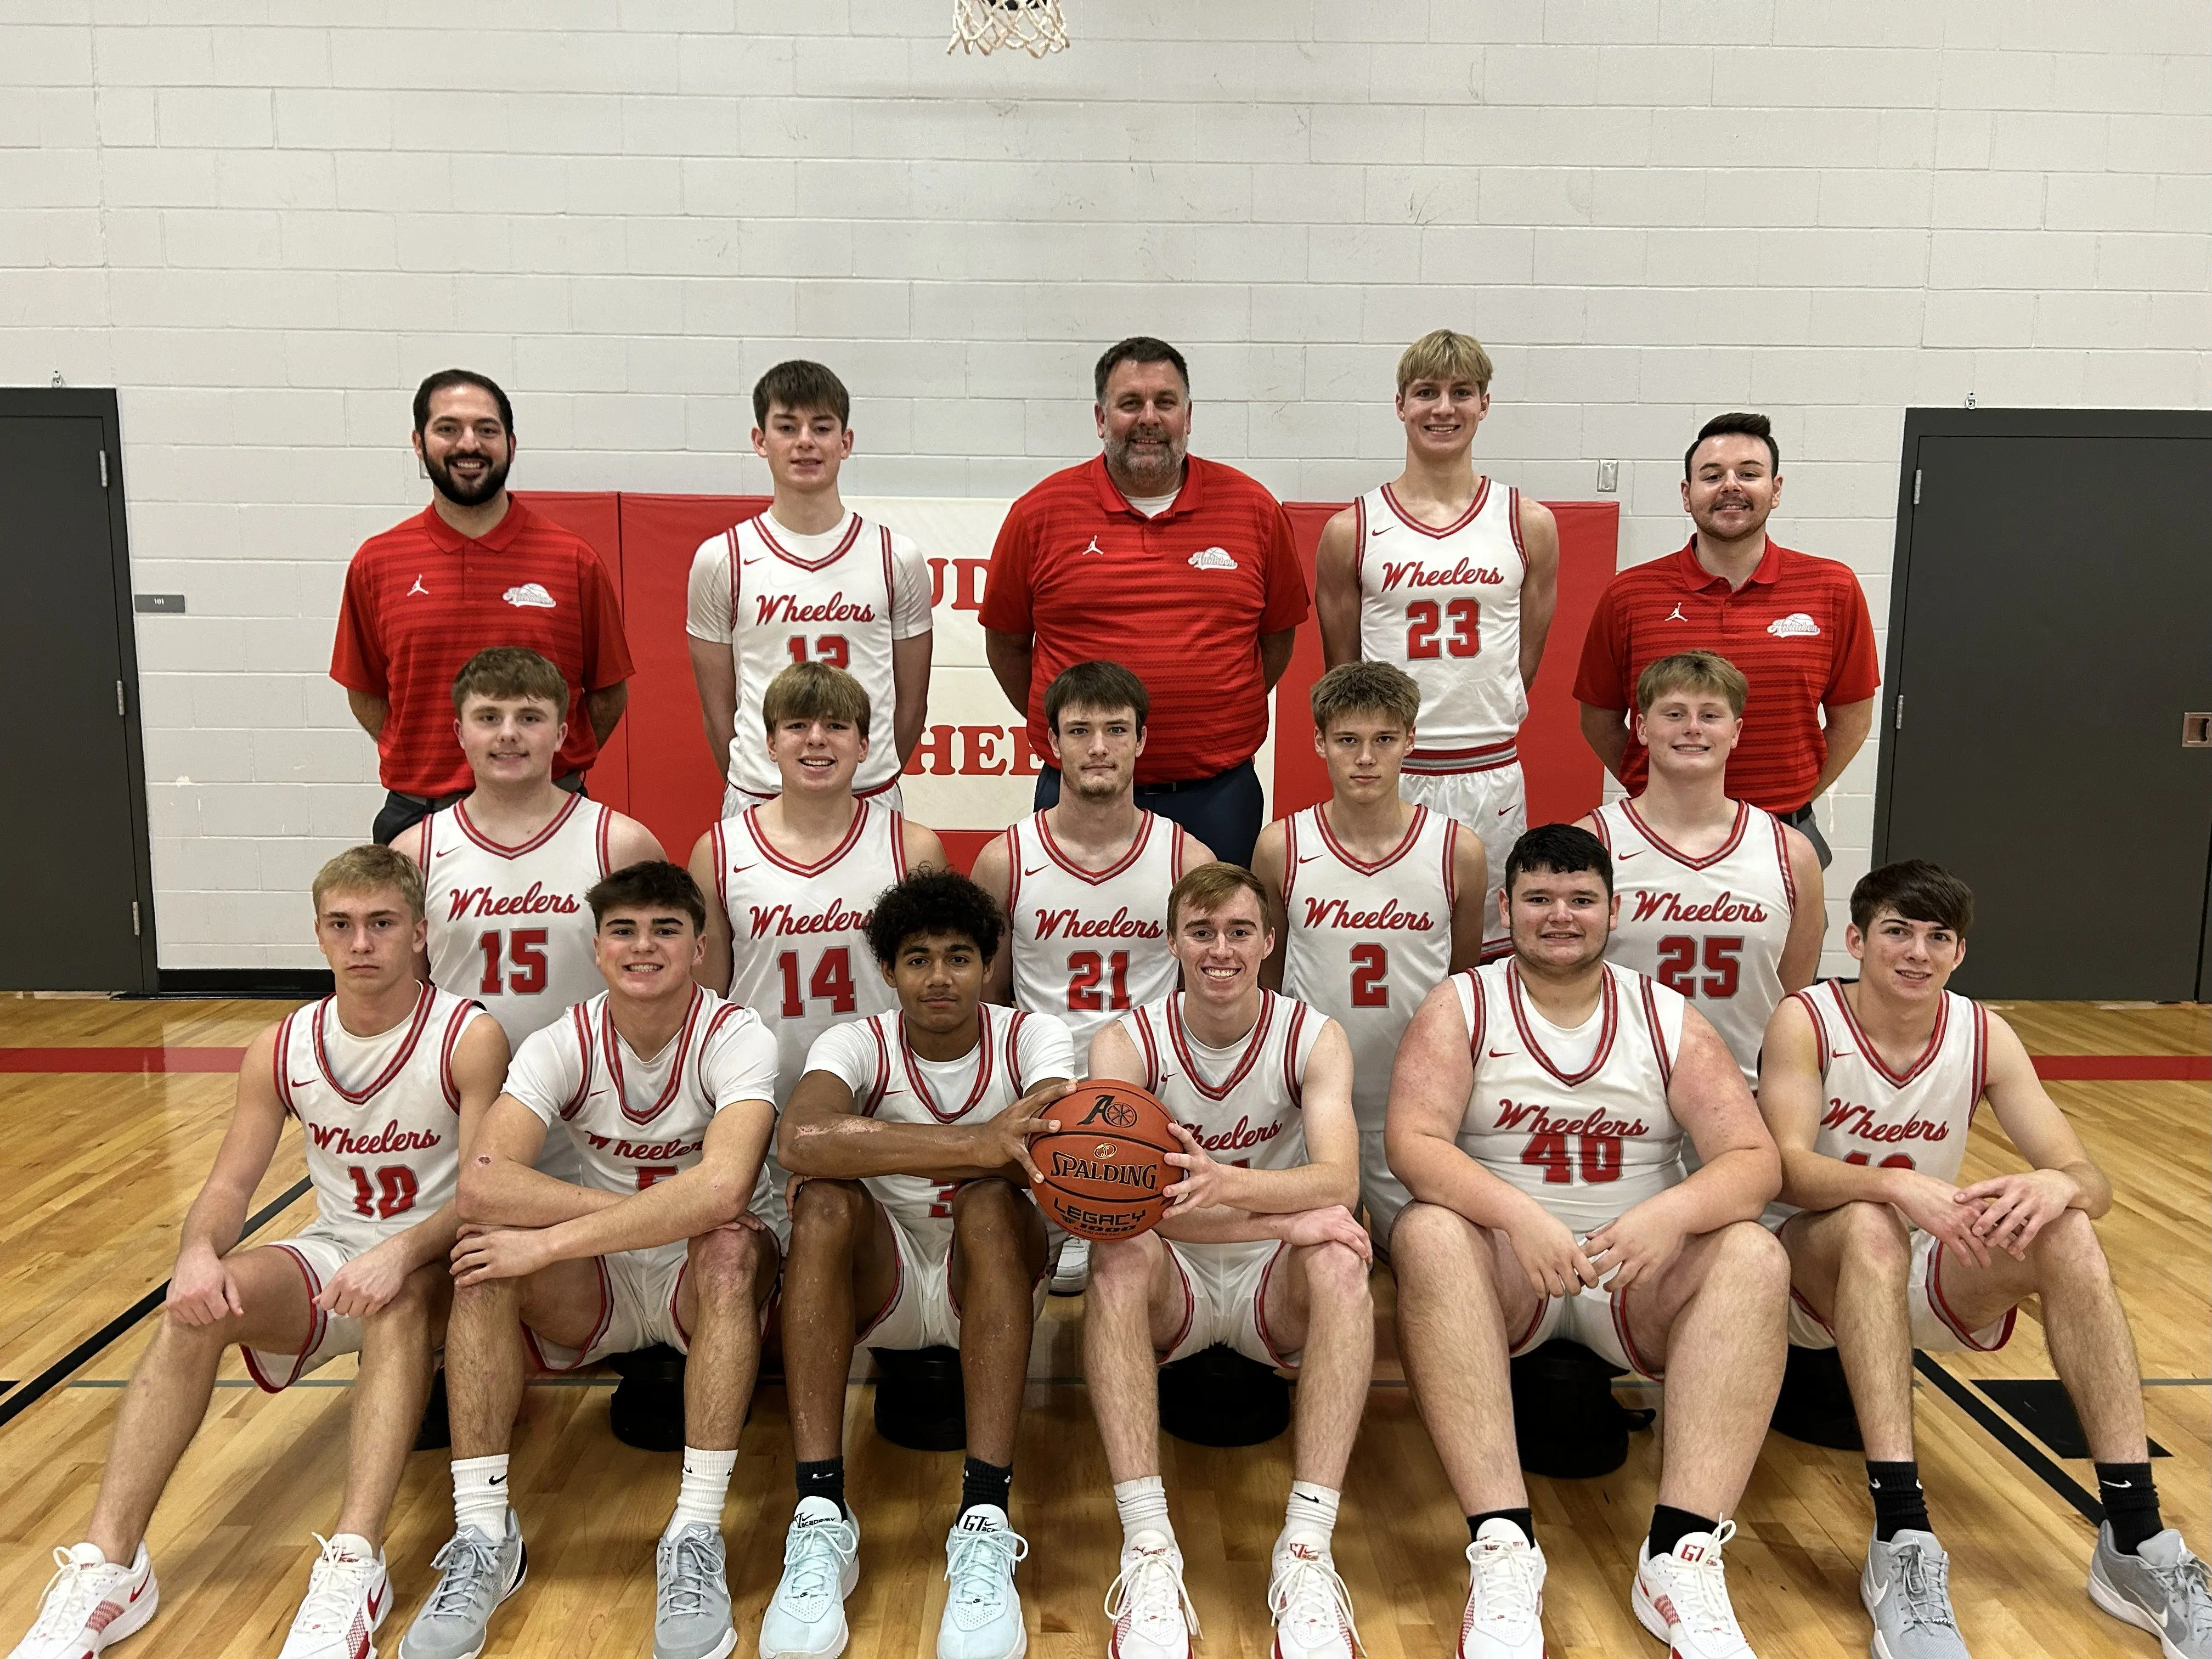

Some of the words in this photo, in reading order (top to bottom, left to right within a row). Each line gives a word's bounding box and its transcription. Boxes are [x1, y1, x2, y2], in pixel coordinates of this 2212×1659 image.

[1381, 557, 1504, 592] Wheelers
[756, 591, 876, 626] Wheelers
[1405, 597, 1482, 661] 23
[447, 881, 580, 922] Wheelers
[1304, 897, 1435, 931] Wheelers
[1630, 890, 1768, 923] Wheelers
[1035, 906, 1164, 940] Wheelers
[478, 927, 549, 996] 15
[1349, 941, 1389, 1008] 2
[1656, 934, 1745, 1000] 25
[776, 945, 857, 1019] 14
[1066, 950, 1132, 1013] 21
[308, 1119, 442, 1154] Wheelers
[1176, 1115, 1283, 1151] heelers
[1493, 1098, 1649, 1136] Wheelers
[1820, 1097, 1949, 1143] Wheelers
[584, 1130, 703, 1160] Wheeler
[1520, 1132, 1624, 1186] 40
[1050, 1150, 1158, 1190] SPALDING
[347, 1164, 420, 1220] 10
[1054, 1197, 1146, 1226] LEGACY
[963, 1515, 990, 1531] GT
